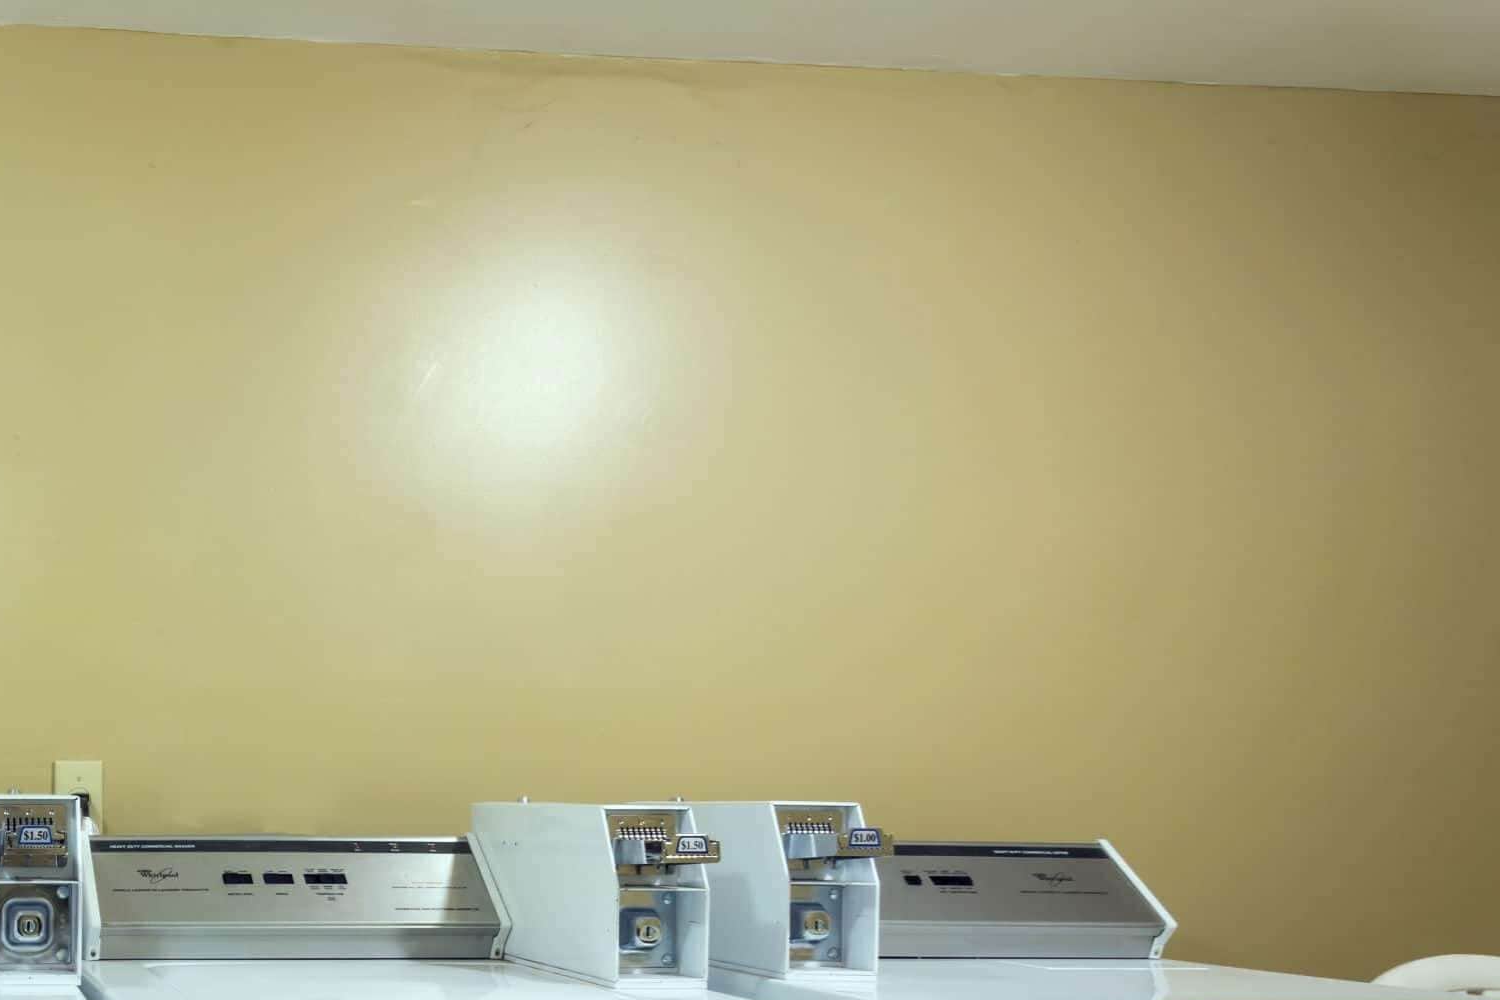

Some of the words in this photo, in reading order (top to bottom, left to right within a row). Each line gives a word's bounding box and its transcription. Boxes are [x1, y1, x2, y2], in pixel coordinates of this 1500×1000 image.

[23, 830, 48, 841] $1.50
[854, 833, 876, 842] $1.00
[681, 840, 704, 850] $1.50
